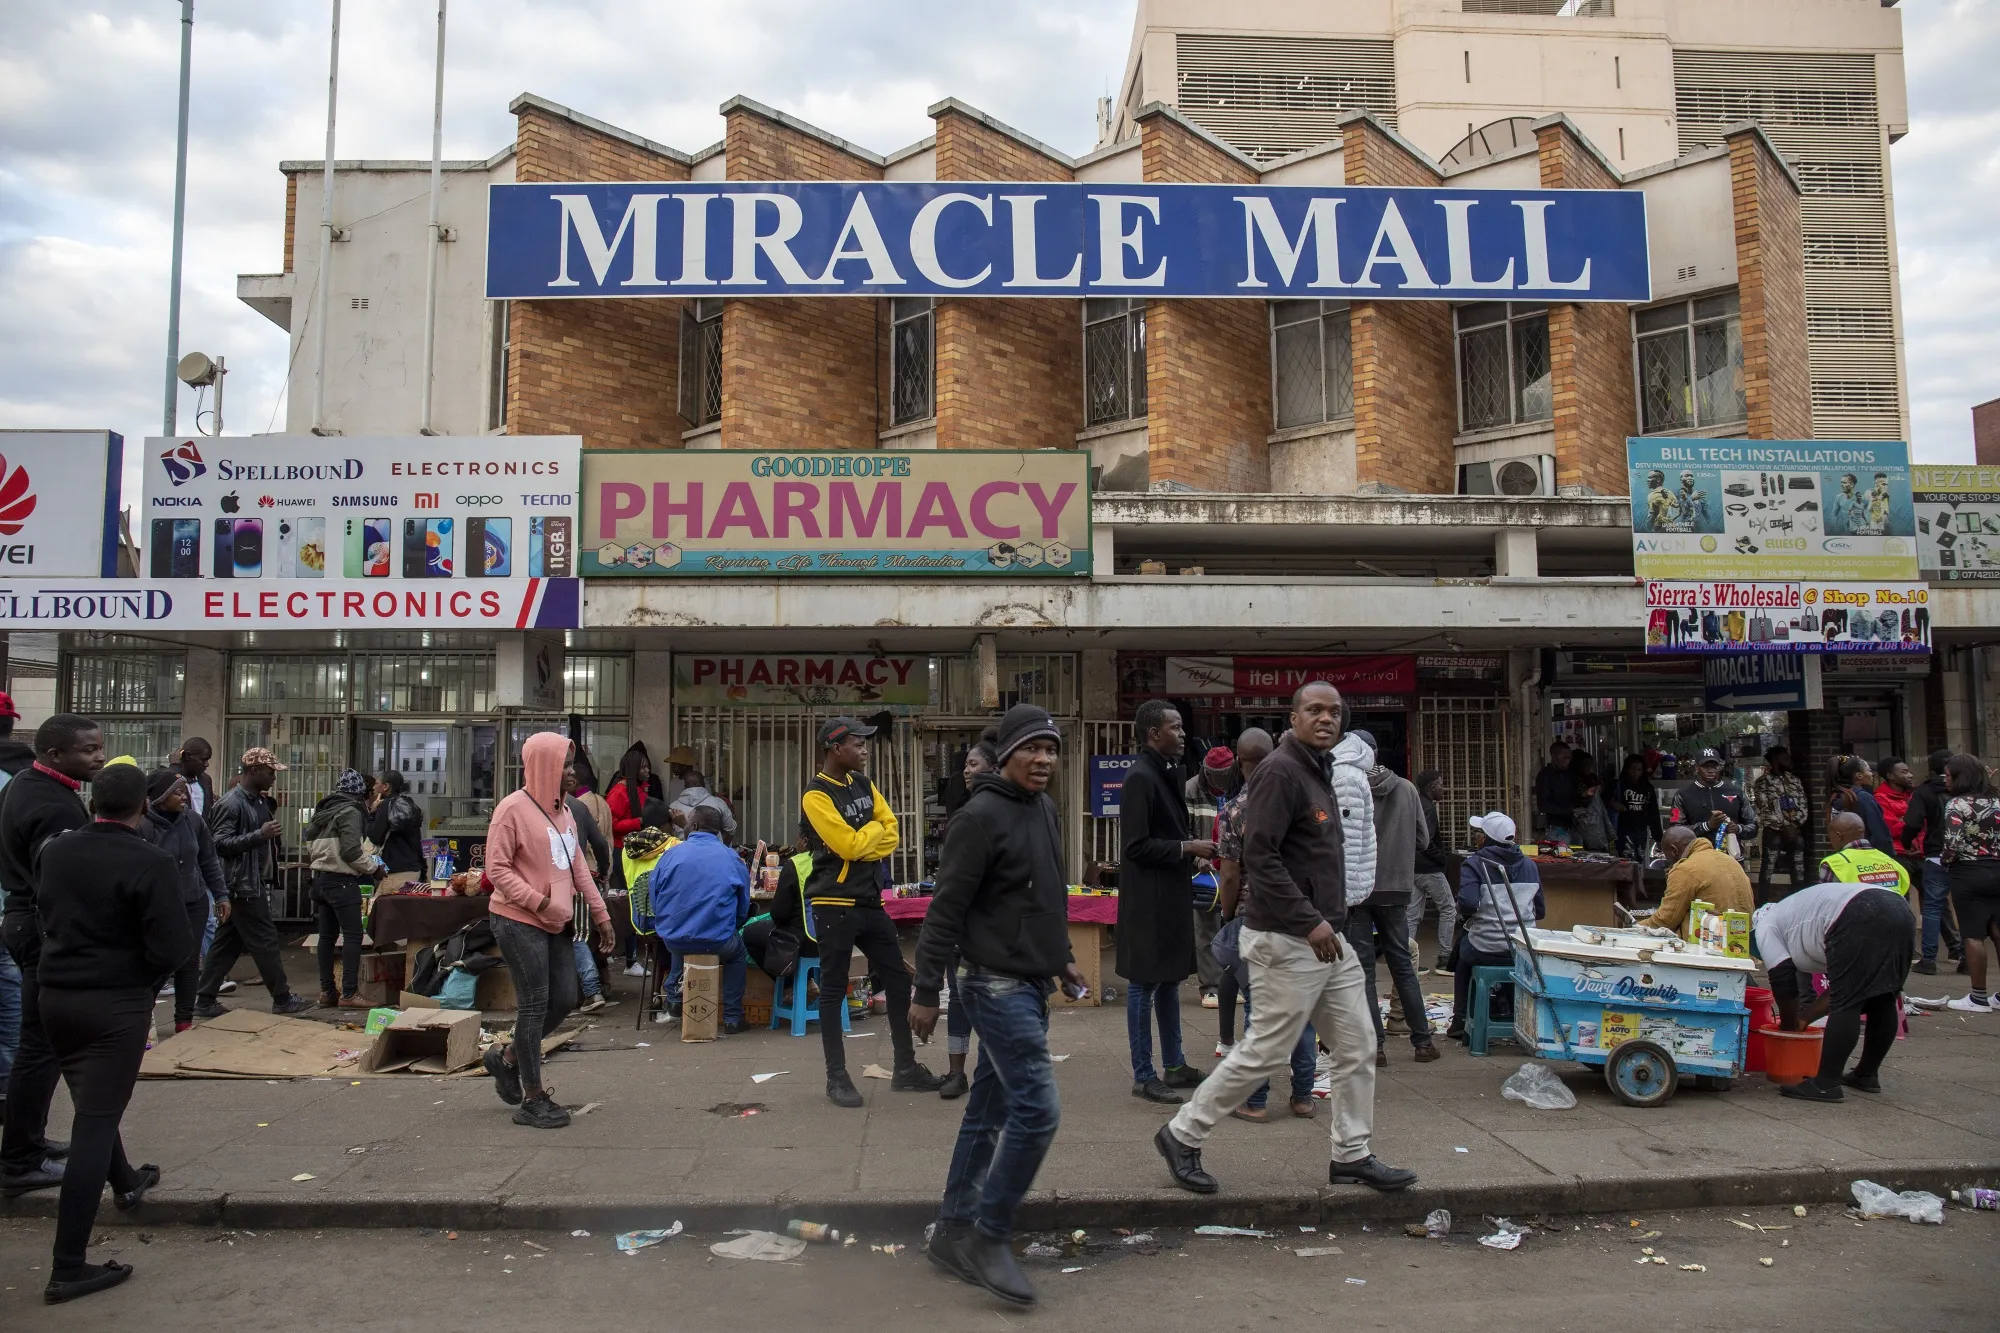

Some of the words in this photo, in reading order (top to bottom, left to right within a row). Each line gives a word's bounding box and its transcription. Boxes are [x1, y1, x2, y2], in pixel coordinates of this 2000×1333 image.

[547, 192, 1169, 287] MIRACLE
[1234, 196, 1592, 293] MALL
[1660, 447, 1695, 461] BILL
[1699, 448, 1745, 462] TECH
[1748, 449, 1875, 463] INSTALLATIONS
[217, 458, 364, 481] SPELLBOUND
[391, 461, 560, 476] ELECTRONICS
[751, 456, 912, 477] GOODHOPE
[152, 497, 203, 507] NOKIA
[277, 498, 316, 506] HUAWEI
[332, 495, 398, 507] SAMSUNG
[520, 494, 572, 506] TECNO
[1923, 493, 1947, 502] YOUR
[1948, 494, 1967, 502] ONE
[1968, 494, 1991, 502] STOP
[600, 480, 1078, 539] PHARMACY
[181, 539, 191, 547] 12
[180, 548, 191, 556] 00
[704, 555, 772, 571] Reviving
[775, 554, 813, 571] Life
[818, 553, 880, 571] Through
[883, 555, 966, 569] Medication
[1648, 583, 1711, 606] Sierra's
[1714, 583, 1800, 607] Wholesale
[1803, 588, 1818, 604] @
[1823, 589, 1870, 607] Shop
[1876, 589, 1928, 604] No.10
[204, 590, 502, 618] ELECTRONICS
[1840, 657, 1889, 665] ACCESSORIES
[1891, 657, 1898, 665] &
[1900, 657, 1930, 665] REPAIRS
[693, 657, 915, 686] PHARMACY
[1249, 670, 1279, 686] itel
[1284, 670, 1308, 685] TV
[1316, 671, 1346, 682] New
[1353, 671, 1399, 682] Arrival
[1705, 655, 1759, 687] MIRACLE
[1763, 654, 1801, 683] MALL
[1857, 862, 1894, 873] EcoCash
[1572, 974, 1616, 998] Dairy
